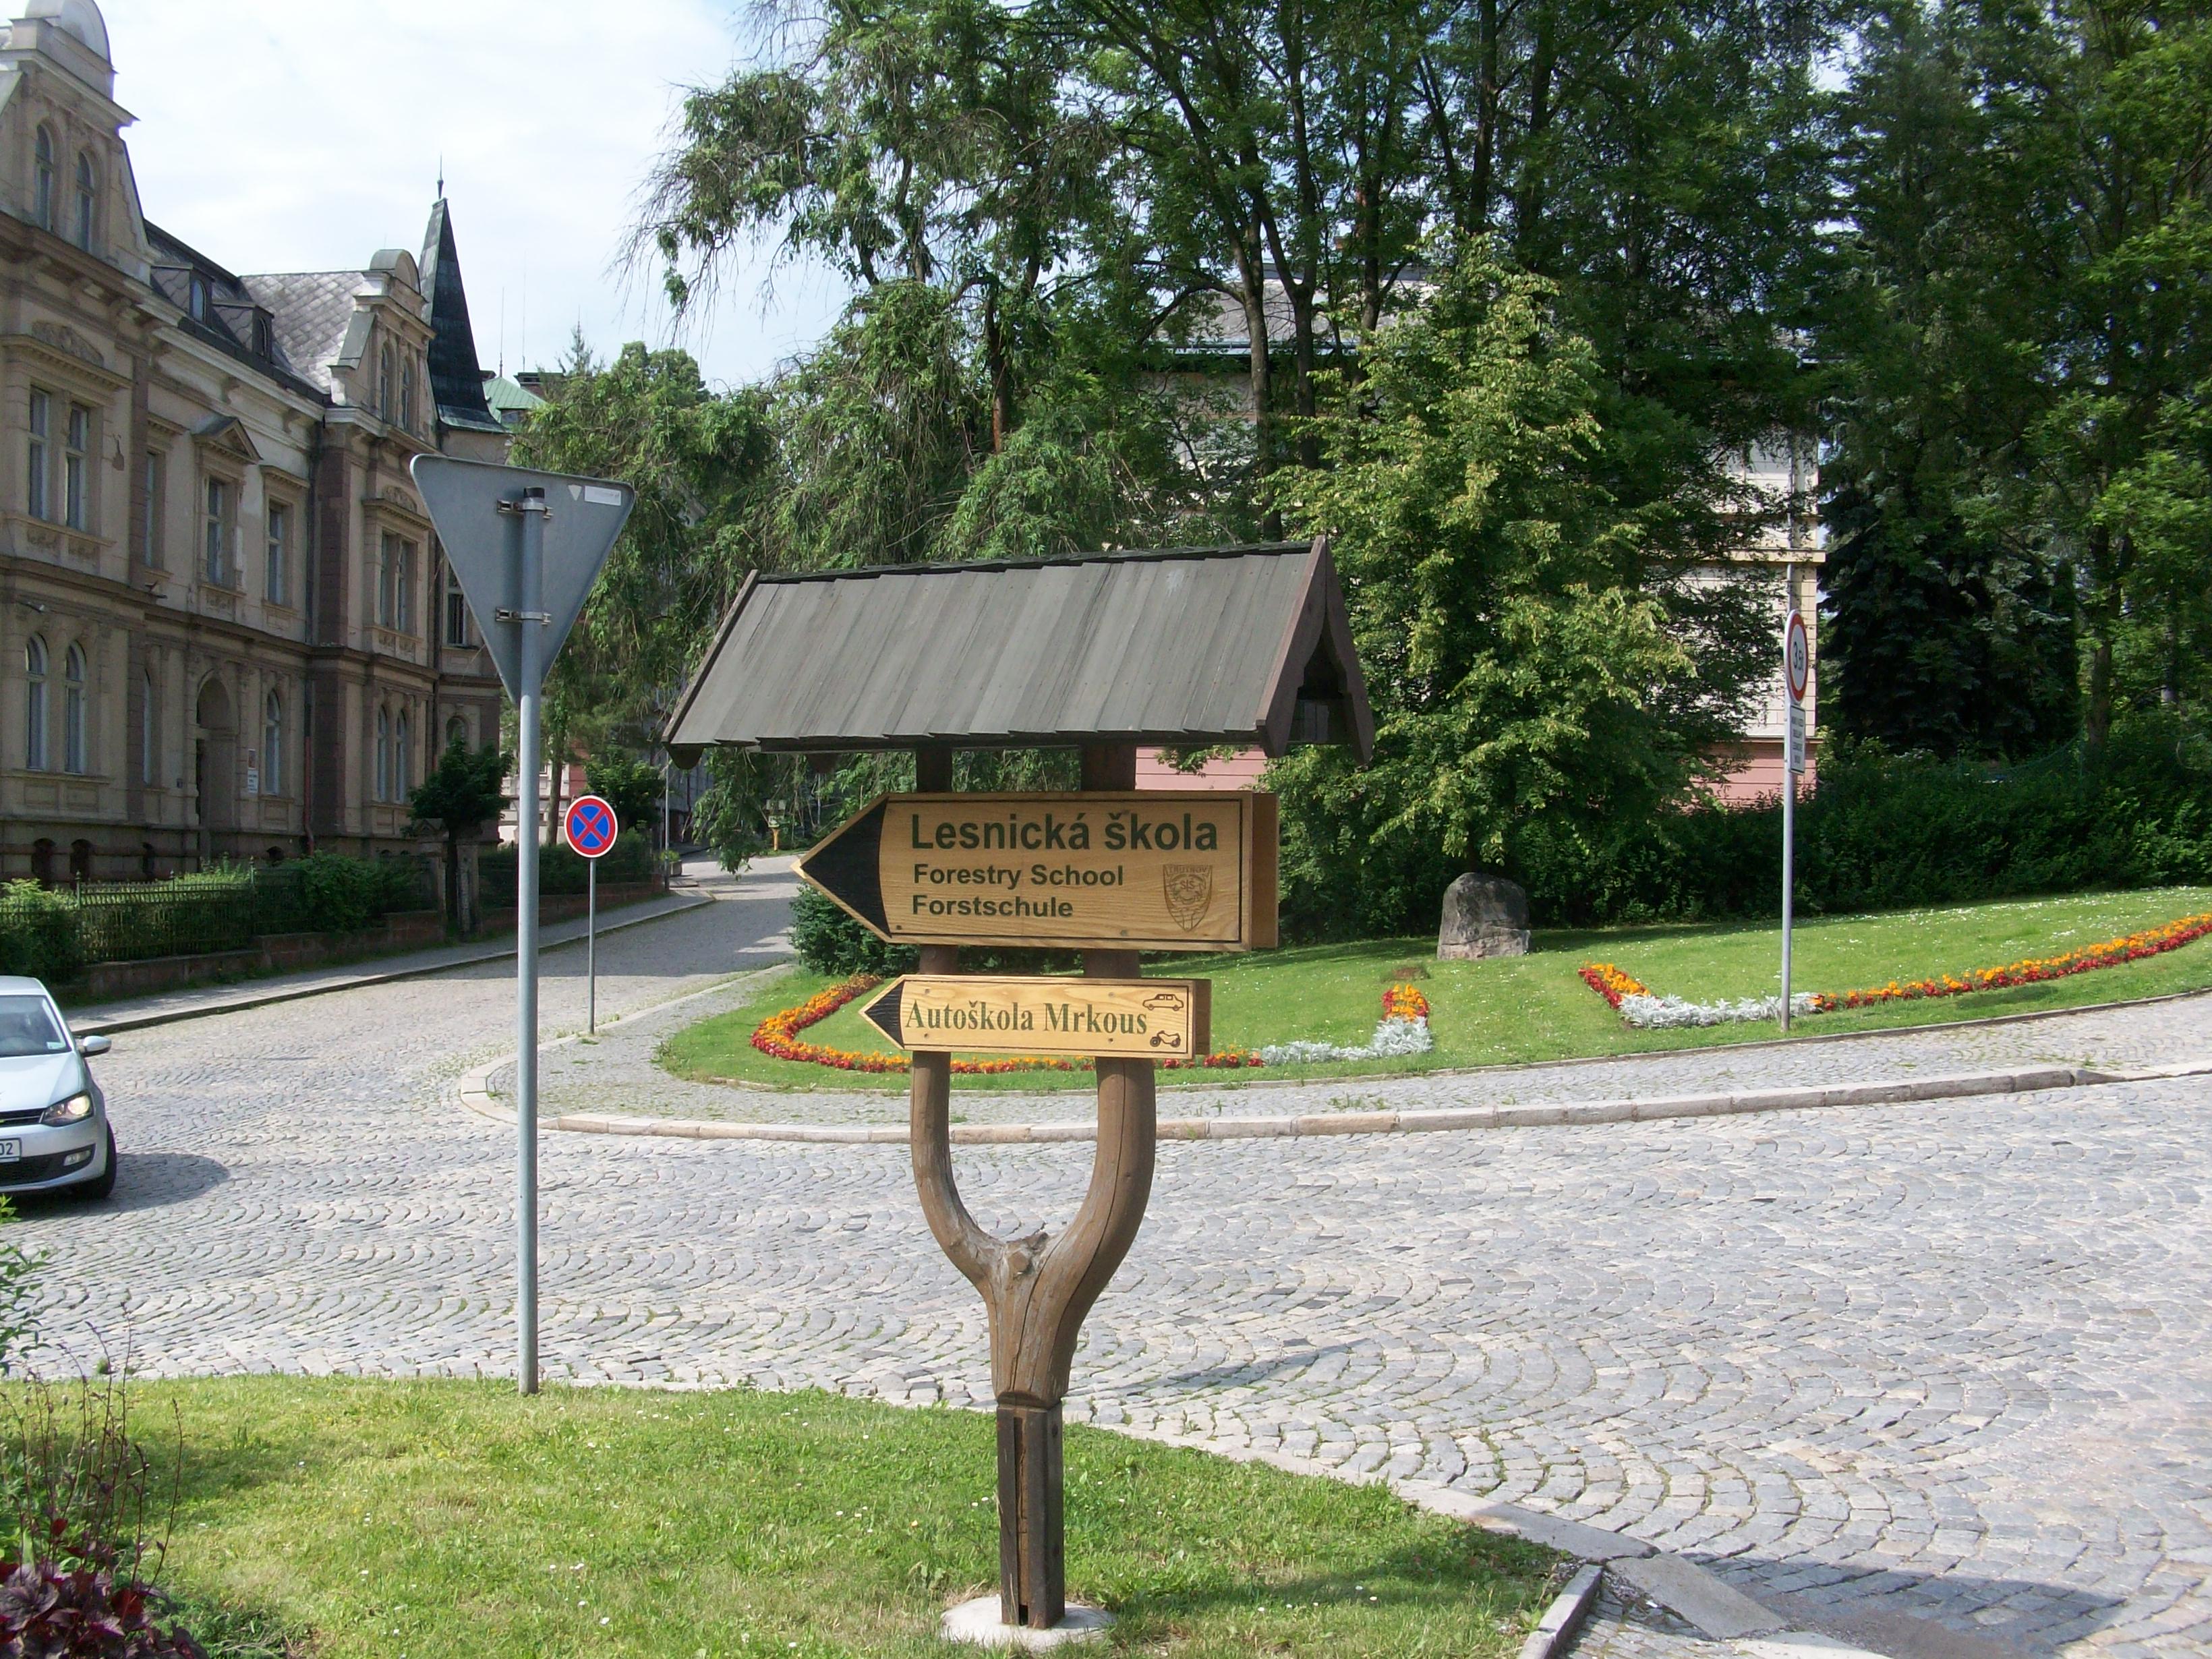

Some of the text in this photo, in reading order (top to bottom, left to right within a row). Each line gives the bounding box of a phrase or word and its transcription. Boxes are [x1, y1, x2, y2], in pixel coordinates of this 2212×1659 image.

[912, 812, 1218, 850] Lesnická škola
[914, 863, 1123, 890] Forestry School
[912, 894, 1074, 917] Forstschule
[905, 998, 1147, 1035] Autoškola Mrkous
